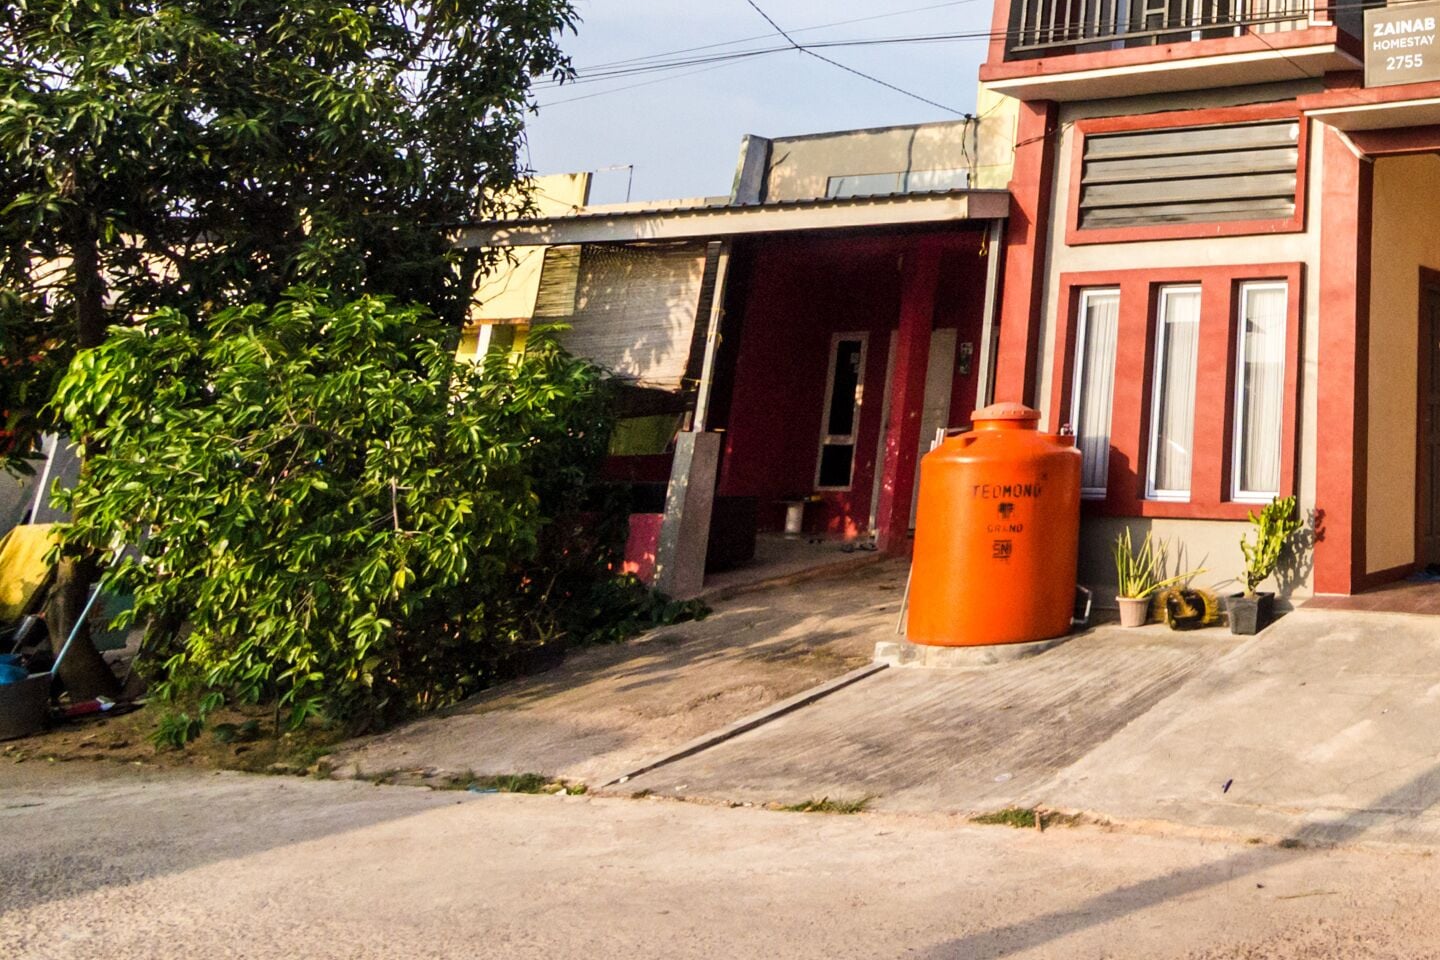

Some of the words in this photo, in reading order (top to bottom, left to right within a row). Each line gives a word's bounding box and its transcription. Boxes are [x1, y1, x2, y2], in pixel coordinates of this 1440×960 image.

[1373, 17, 1436, 37] ZAINAB
[1373, 34, 1436, 51] HOMESTAY
[1386, 53, 1423, 70] 2755
